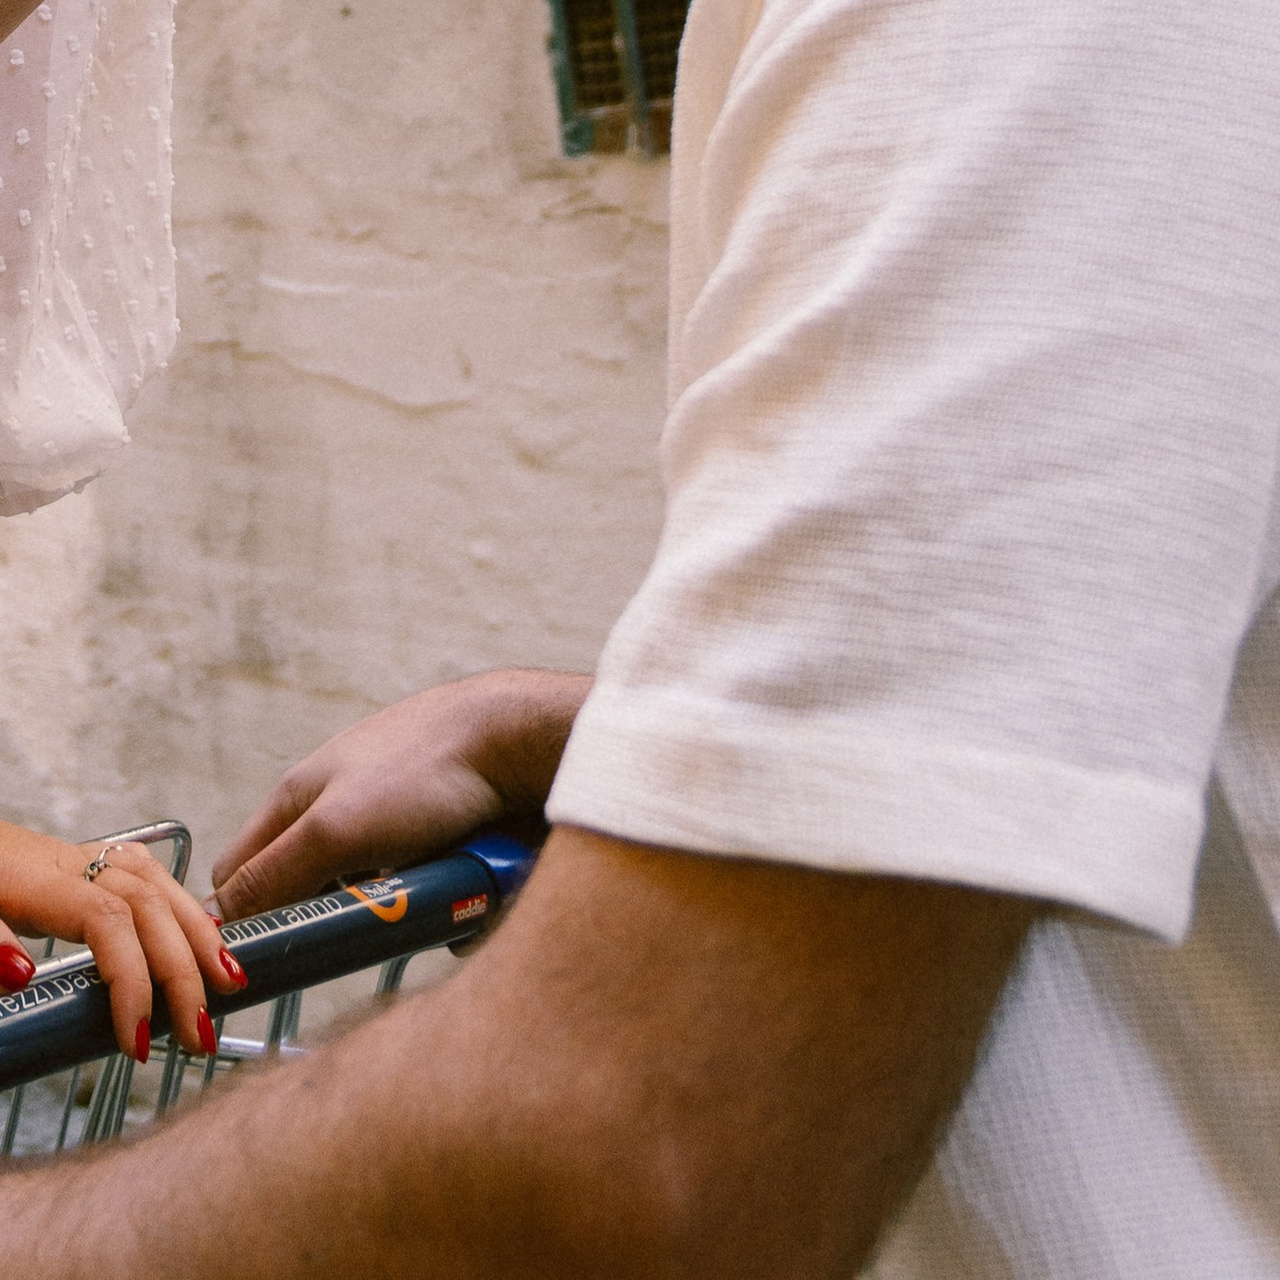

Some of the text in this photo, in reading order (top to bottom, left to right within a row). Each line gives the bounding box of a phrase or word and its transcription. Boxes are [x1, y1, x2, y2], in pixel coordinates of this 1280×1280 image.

[453, 898, 487, 922] caddie
[53, 968, 104, 997] bas
[220, 915, 272, 943] orni
